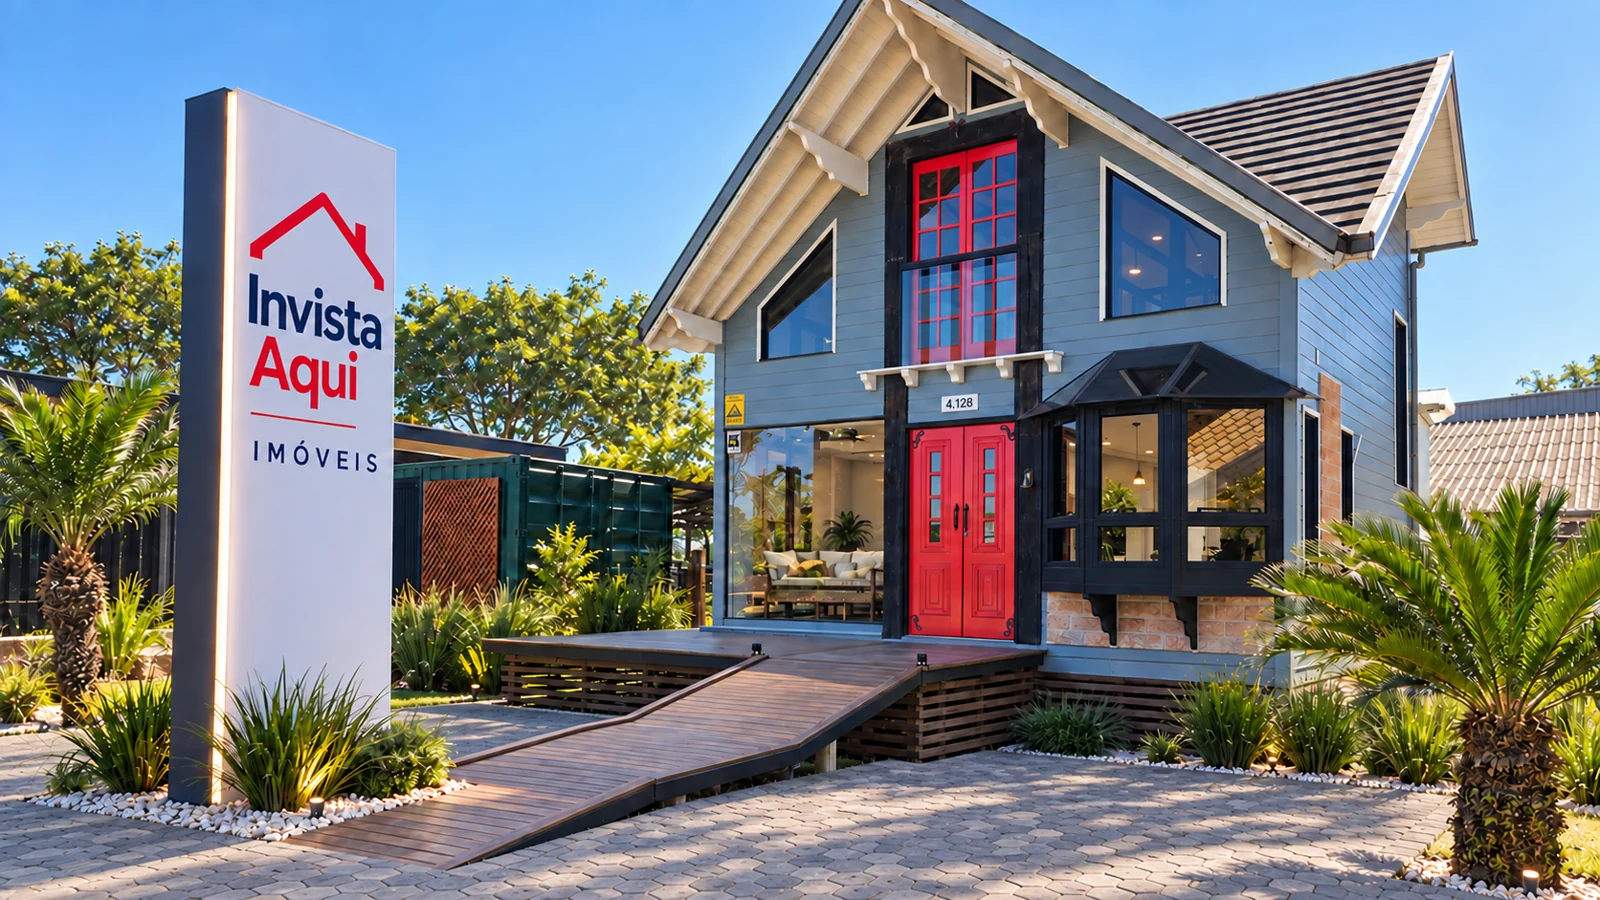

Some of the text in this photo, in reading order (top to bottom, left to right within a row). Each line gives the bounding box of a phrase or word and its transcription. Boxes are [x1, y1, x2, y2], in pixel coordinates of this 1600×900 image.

[249, 273, 382, 350] Invista
[250, 335, 357, 410] Aqui
[945, 397, 973, 409] 4.128
[253, 440, 378, 473] IMÓVEIS
